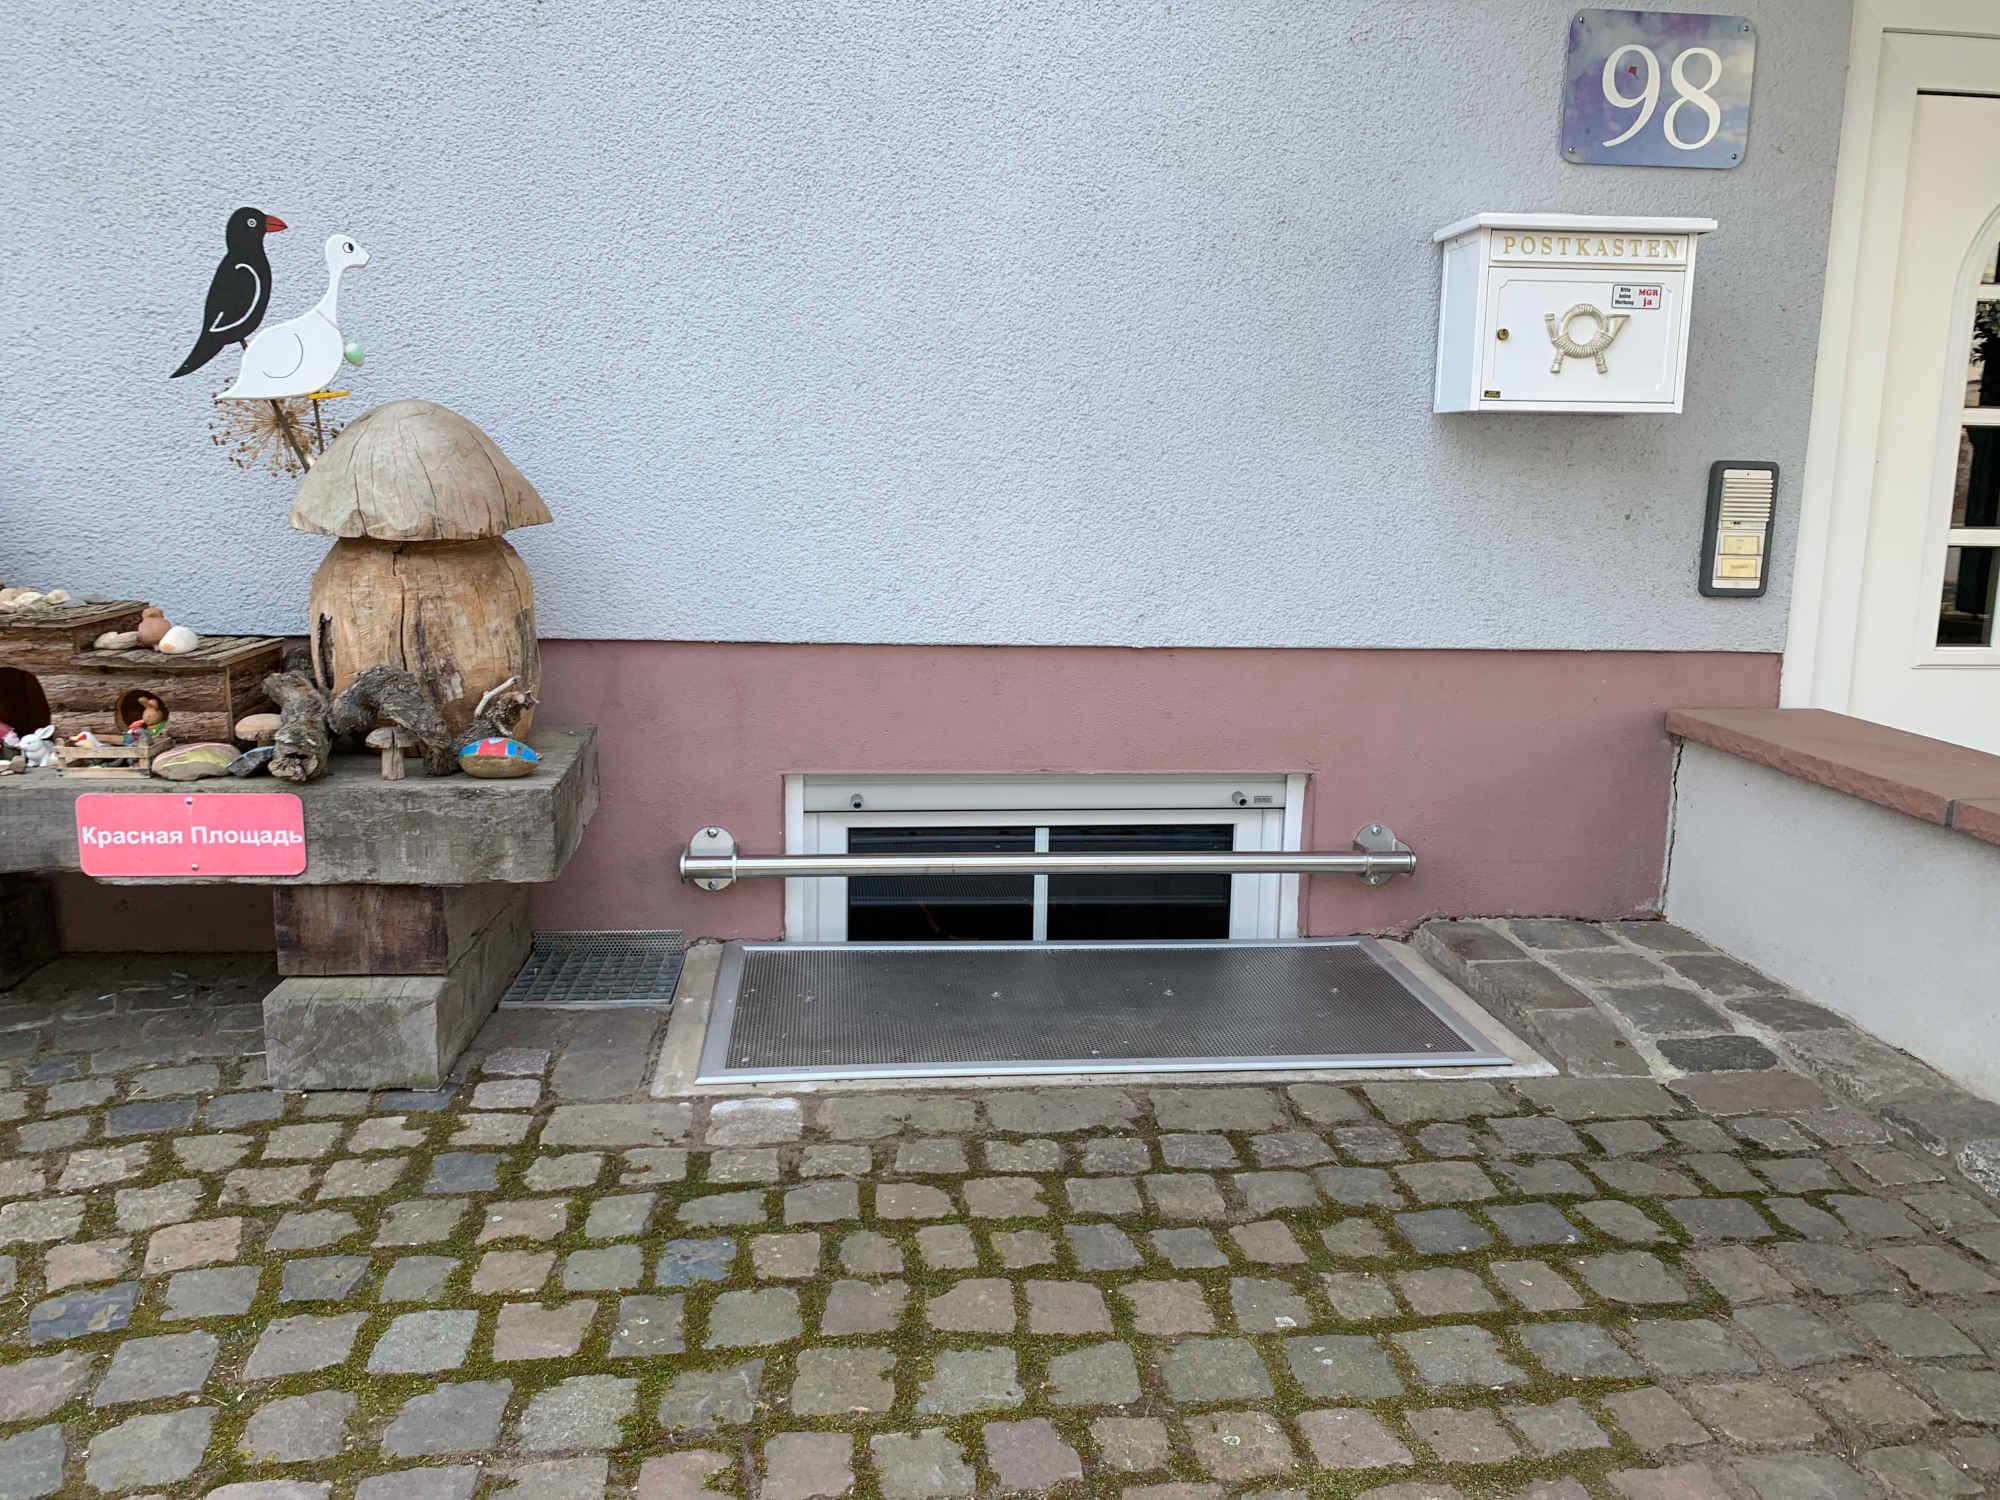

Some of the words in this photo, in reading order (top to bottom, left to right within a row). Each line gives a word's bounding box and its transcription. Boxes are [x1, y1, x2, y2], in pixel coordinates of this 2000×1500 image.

[1602, 43, 1722, 150] 98
[1503, 236, 1680, 258] POSTKASTEN
[82, 826, 183, 848] Красная
[191, 826, 304, 846] Площадь
